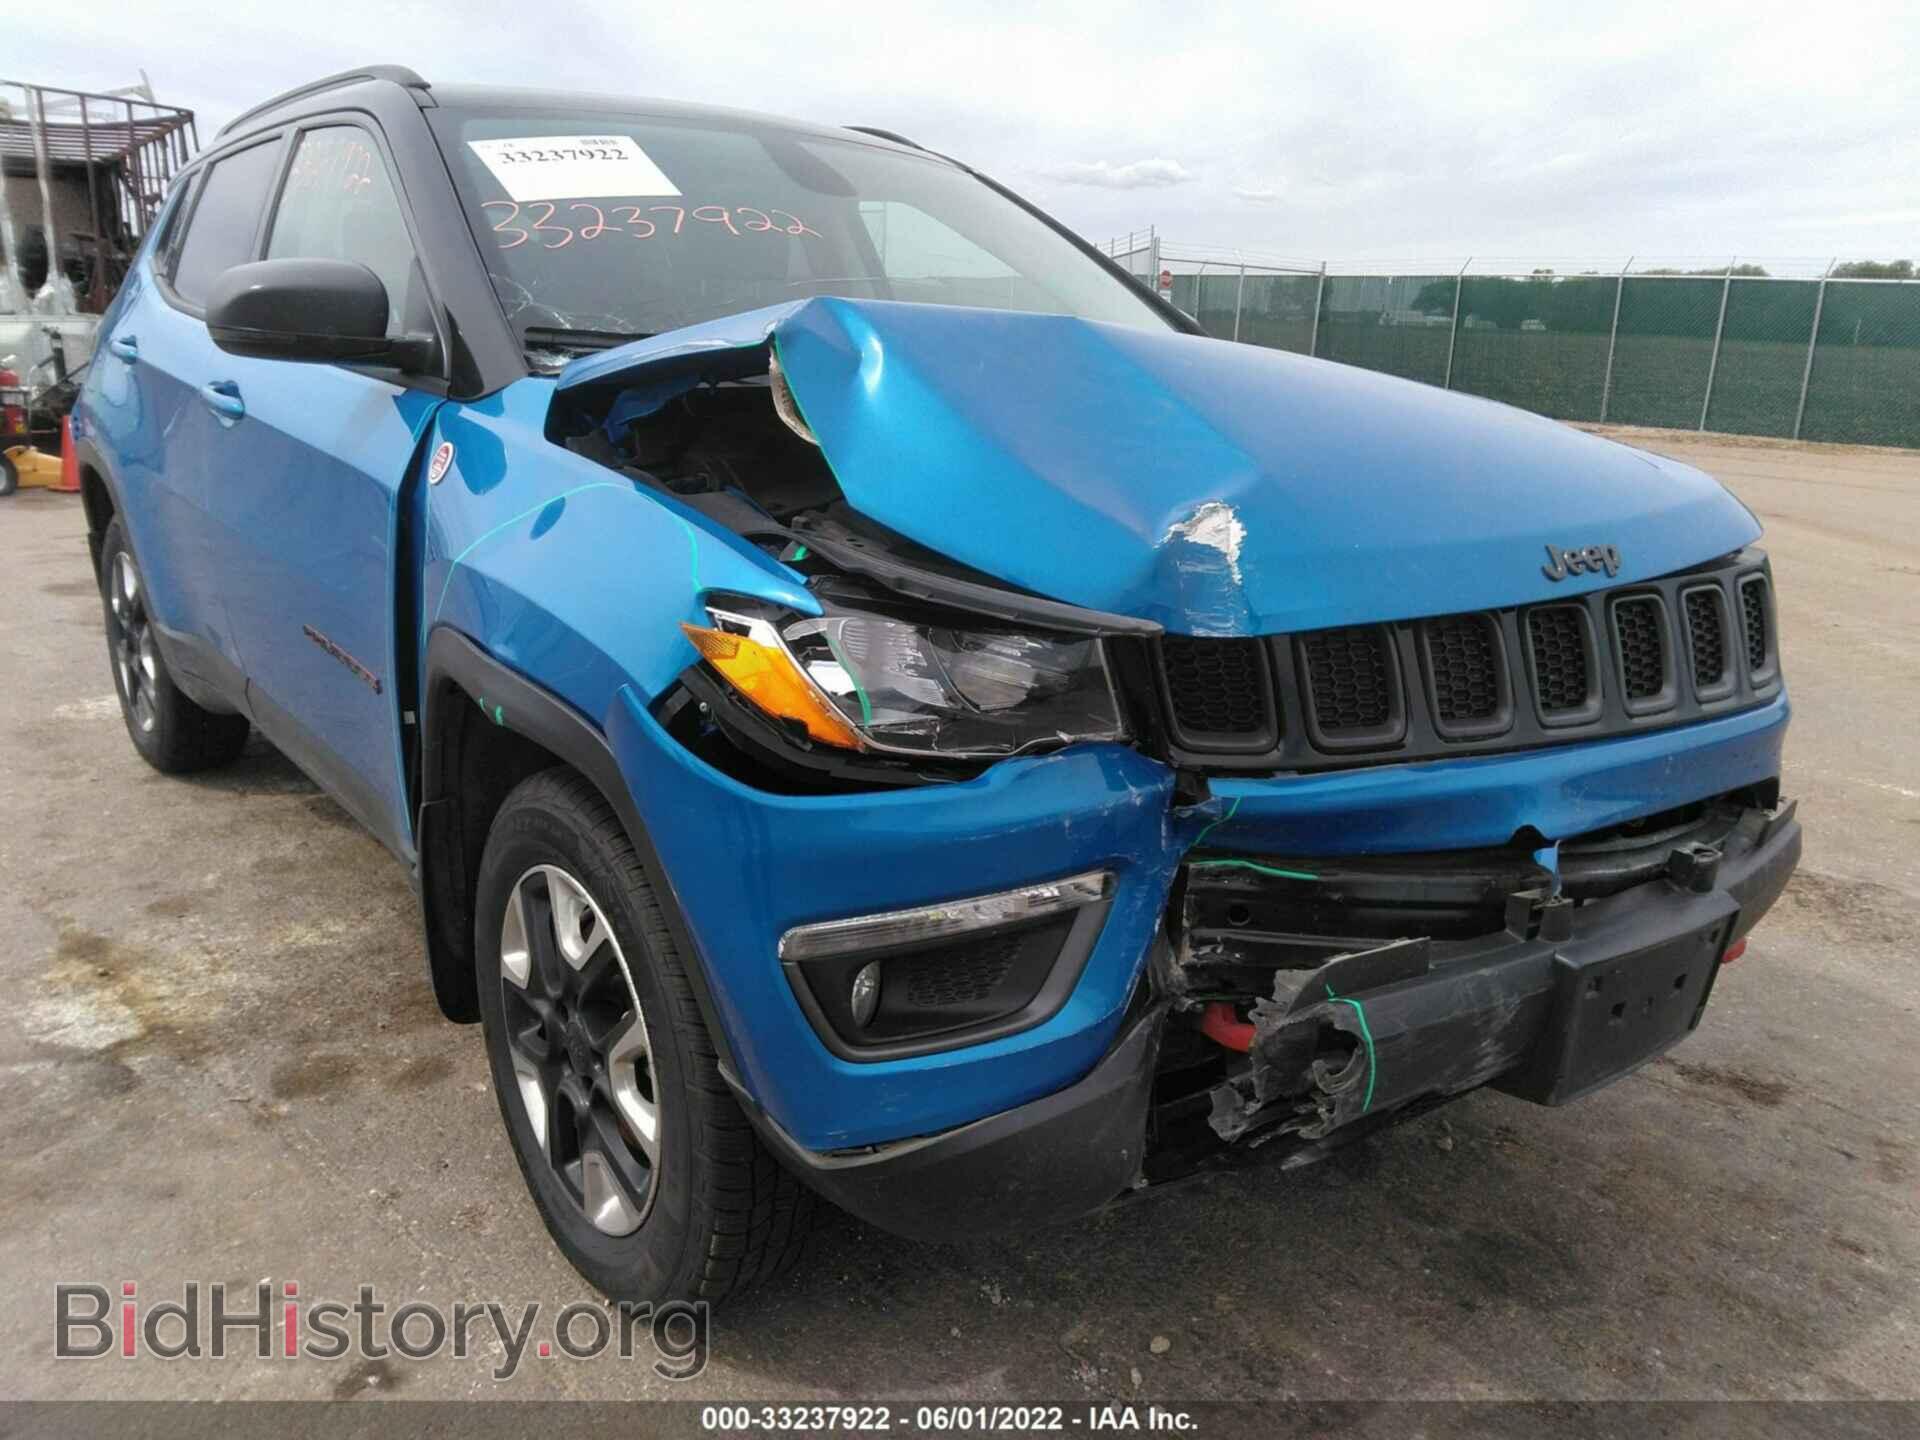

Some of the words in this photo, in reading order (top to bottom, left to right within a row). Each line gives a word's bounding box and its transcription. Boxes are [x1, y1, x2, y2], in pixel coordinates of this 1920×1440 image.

[499, 147, 629, 165] 33237922
[480, 200, 824, 249] 33237922
[1542, 544, 1619, 581] Jeep
